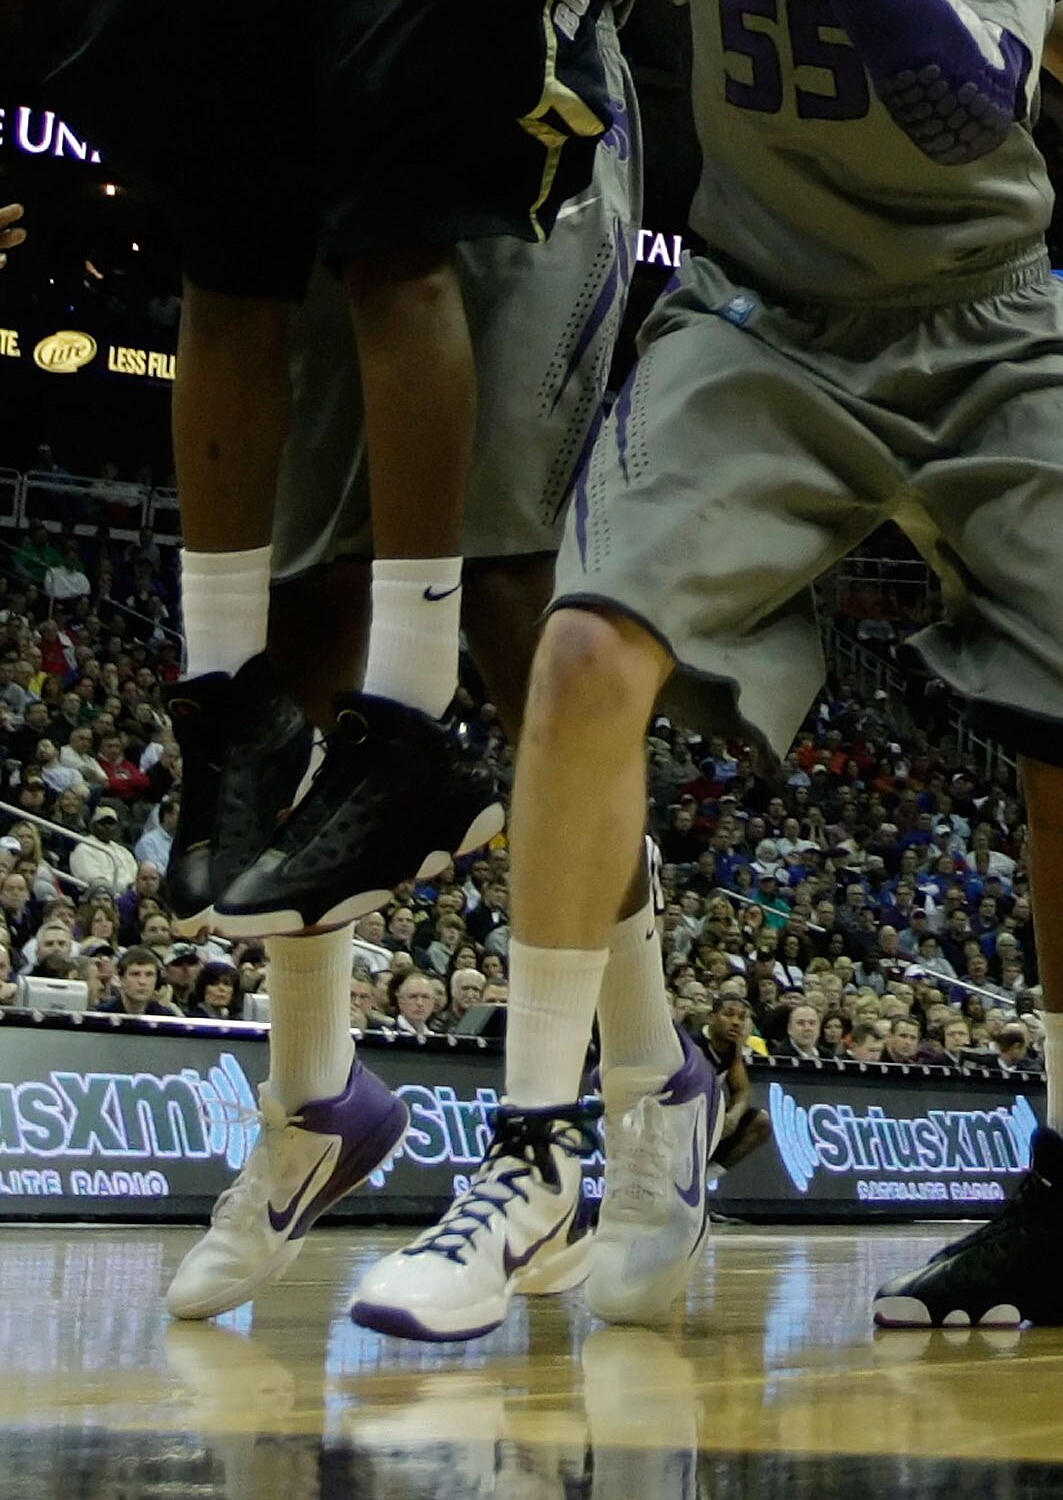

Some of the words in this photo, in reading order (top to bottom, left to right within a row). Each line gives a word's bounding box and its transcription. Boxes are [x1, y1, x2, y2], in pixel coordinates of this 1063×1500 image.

[18, 106, 102, 164] UN
[108, 345, 147, 376] LESS
[70, 1169, 170, 1196] RADIO
